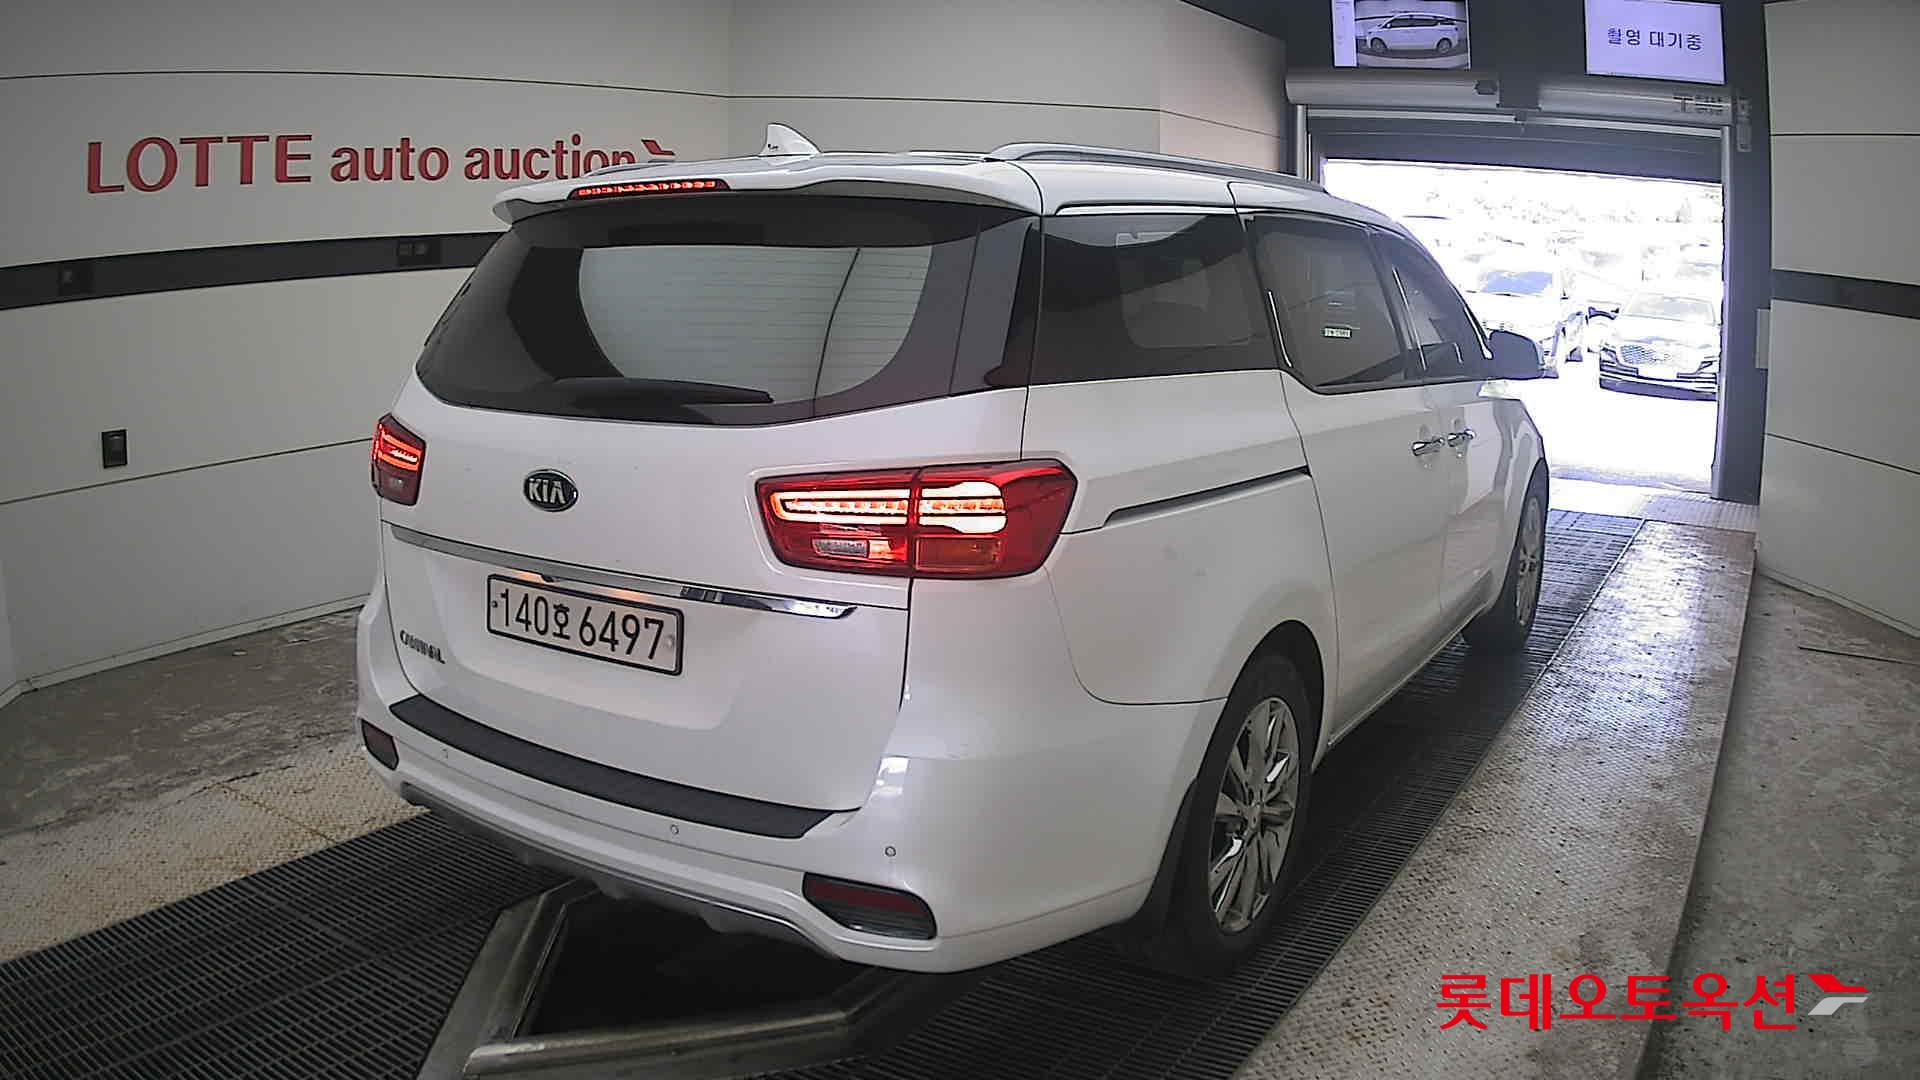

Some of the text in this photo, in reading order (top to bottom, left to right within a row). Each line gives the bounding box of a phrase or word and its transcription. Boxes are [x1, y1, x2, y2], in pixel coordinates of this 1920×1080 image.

[1649, 31, 1702, 51] 대기중
[87, 134, 312, 194] LOTTE
[330, 137, 450, 182] auto
[528, 478, 566, 504] KIA
